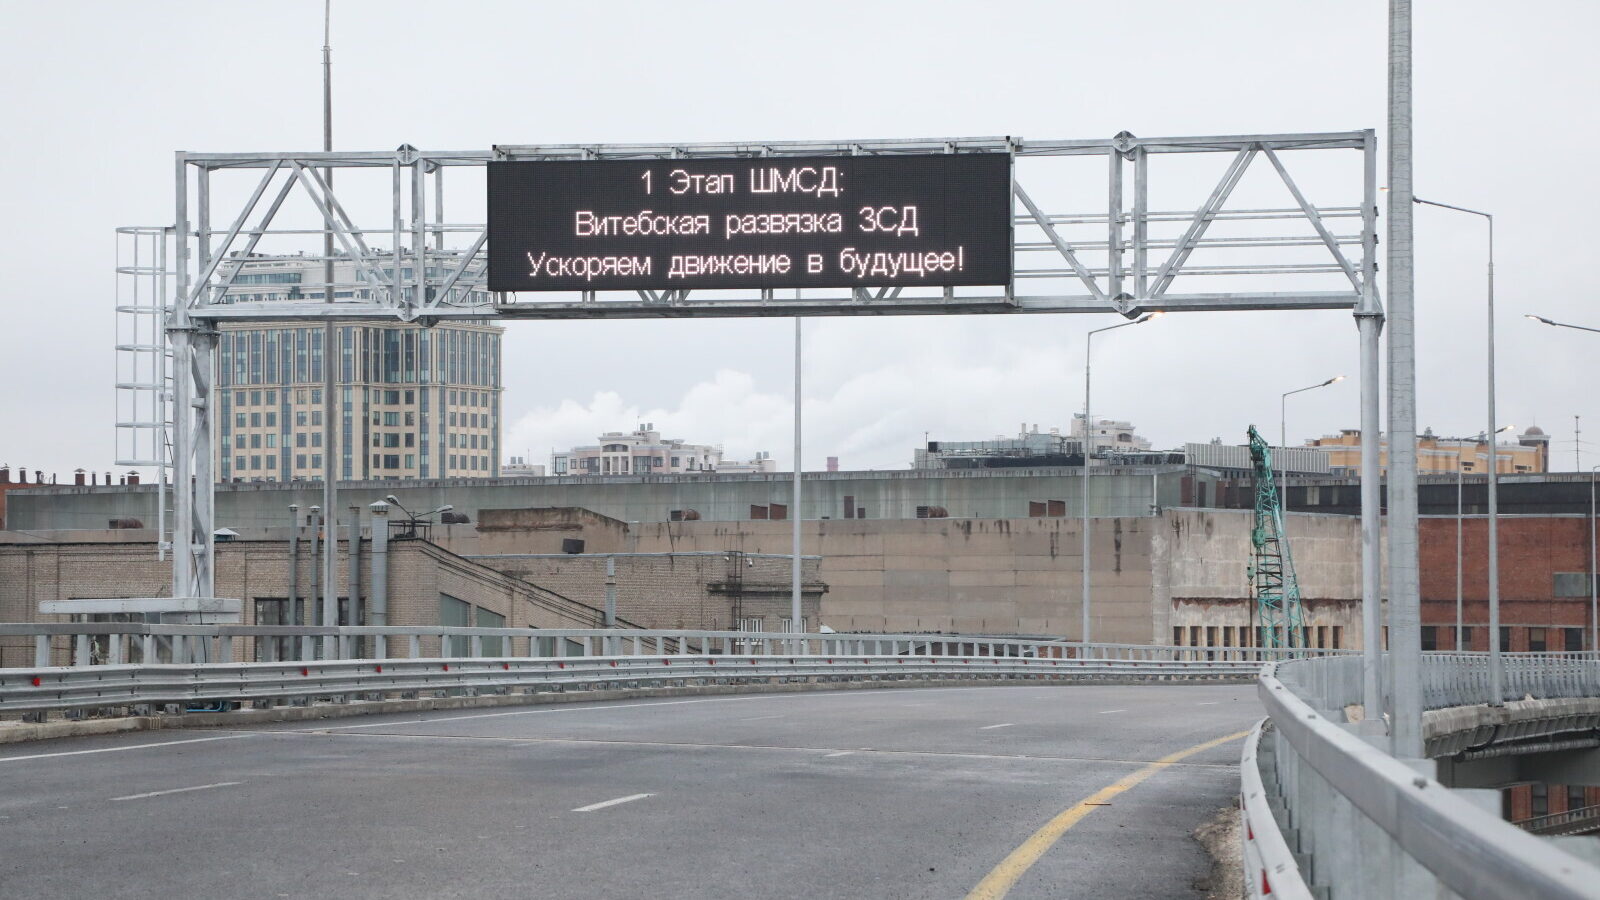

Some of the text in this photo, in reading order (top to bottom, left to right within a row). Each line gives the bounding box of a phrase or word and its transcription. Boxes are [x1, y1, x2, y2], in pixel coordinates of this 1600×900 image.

[641, 166, 844, 198] 1 Этап ШМСД:
[575, 206, 920, 239] Витебская развязка ЗСД
[527, 246, 964, 281] Ускоряем движение в будущее!
